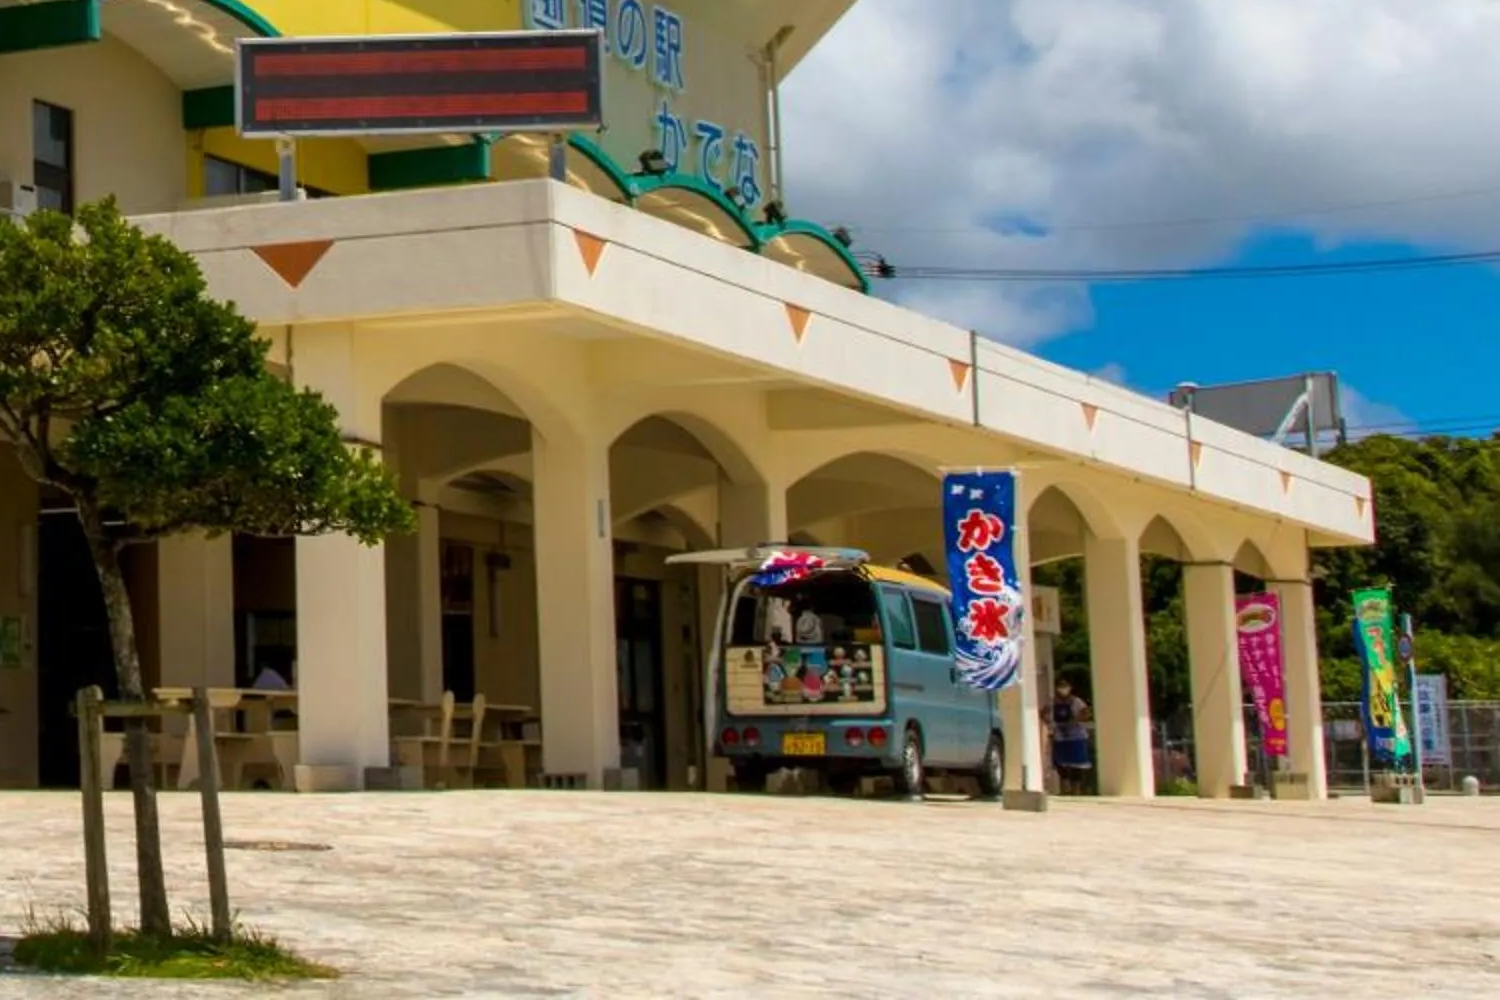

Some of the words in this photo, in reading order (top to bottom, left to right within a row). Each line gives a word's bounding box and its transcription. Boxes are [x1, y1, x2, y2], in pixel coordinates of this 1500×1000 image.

[656, 100, 763, 205] かでな
[957, 508, 1009, 647] かき氷
